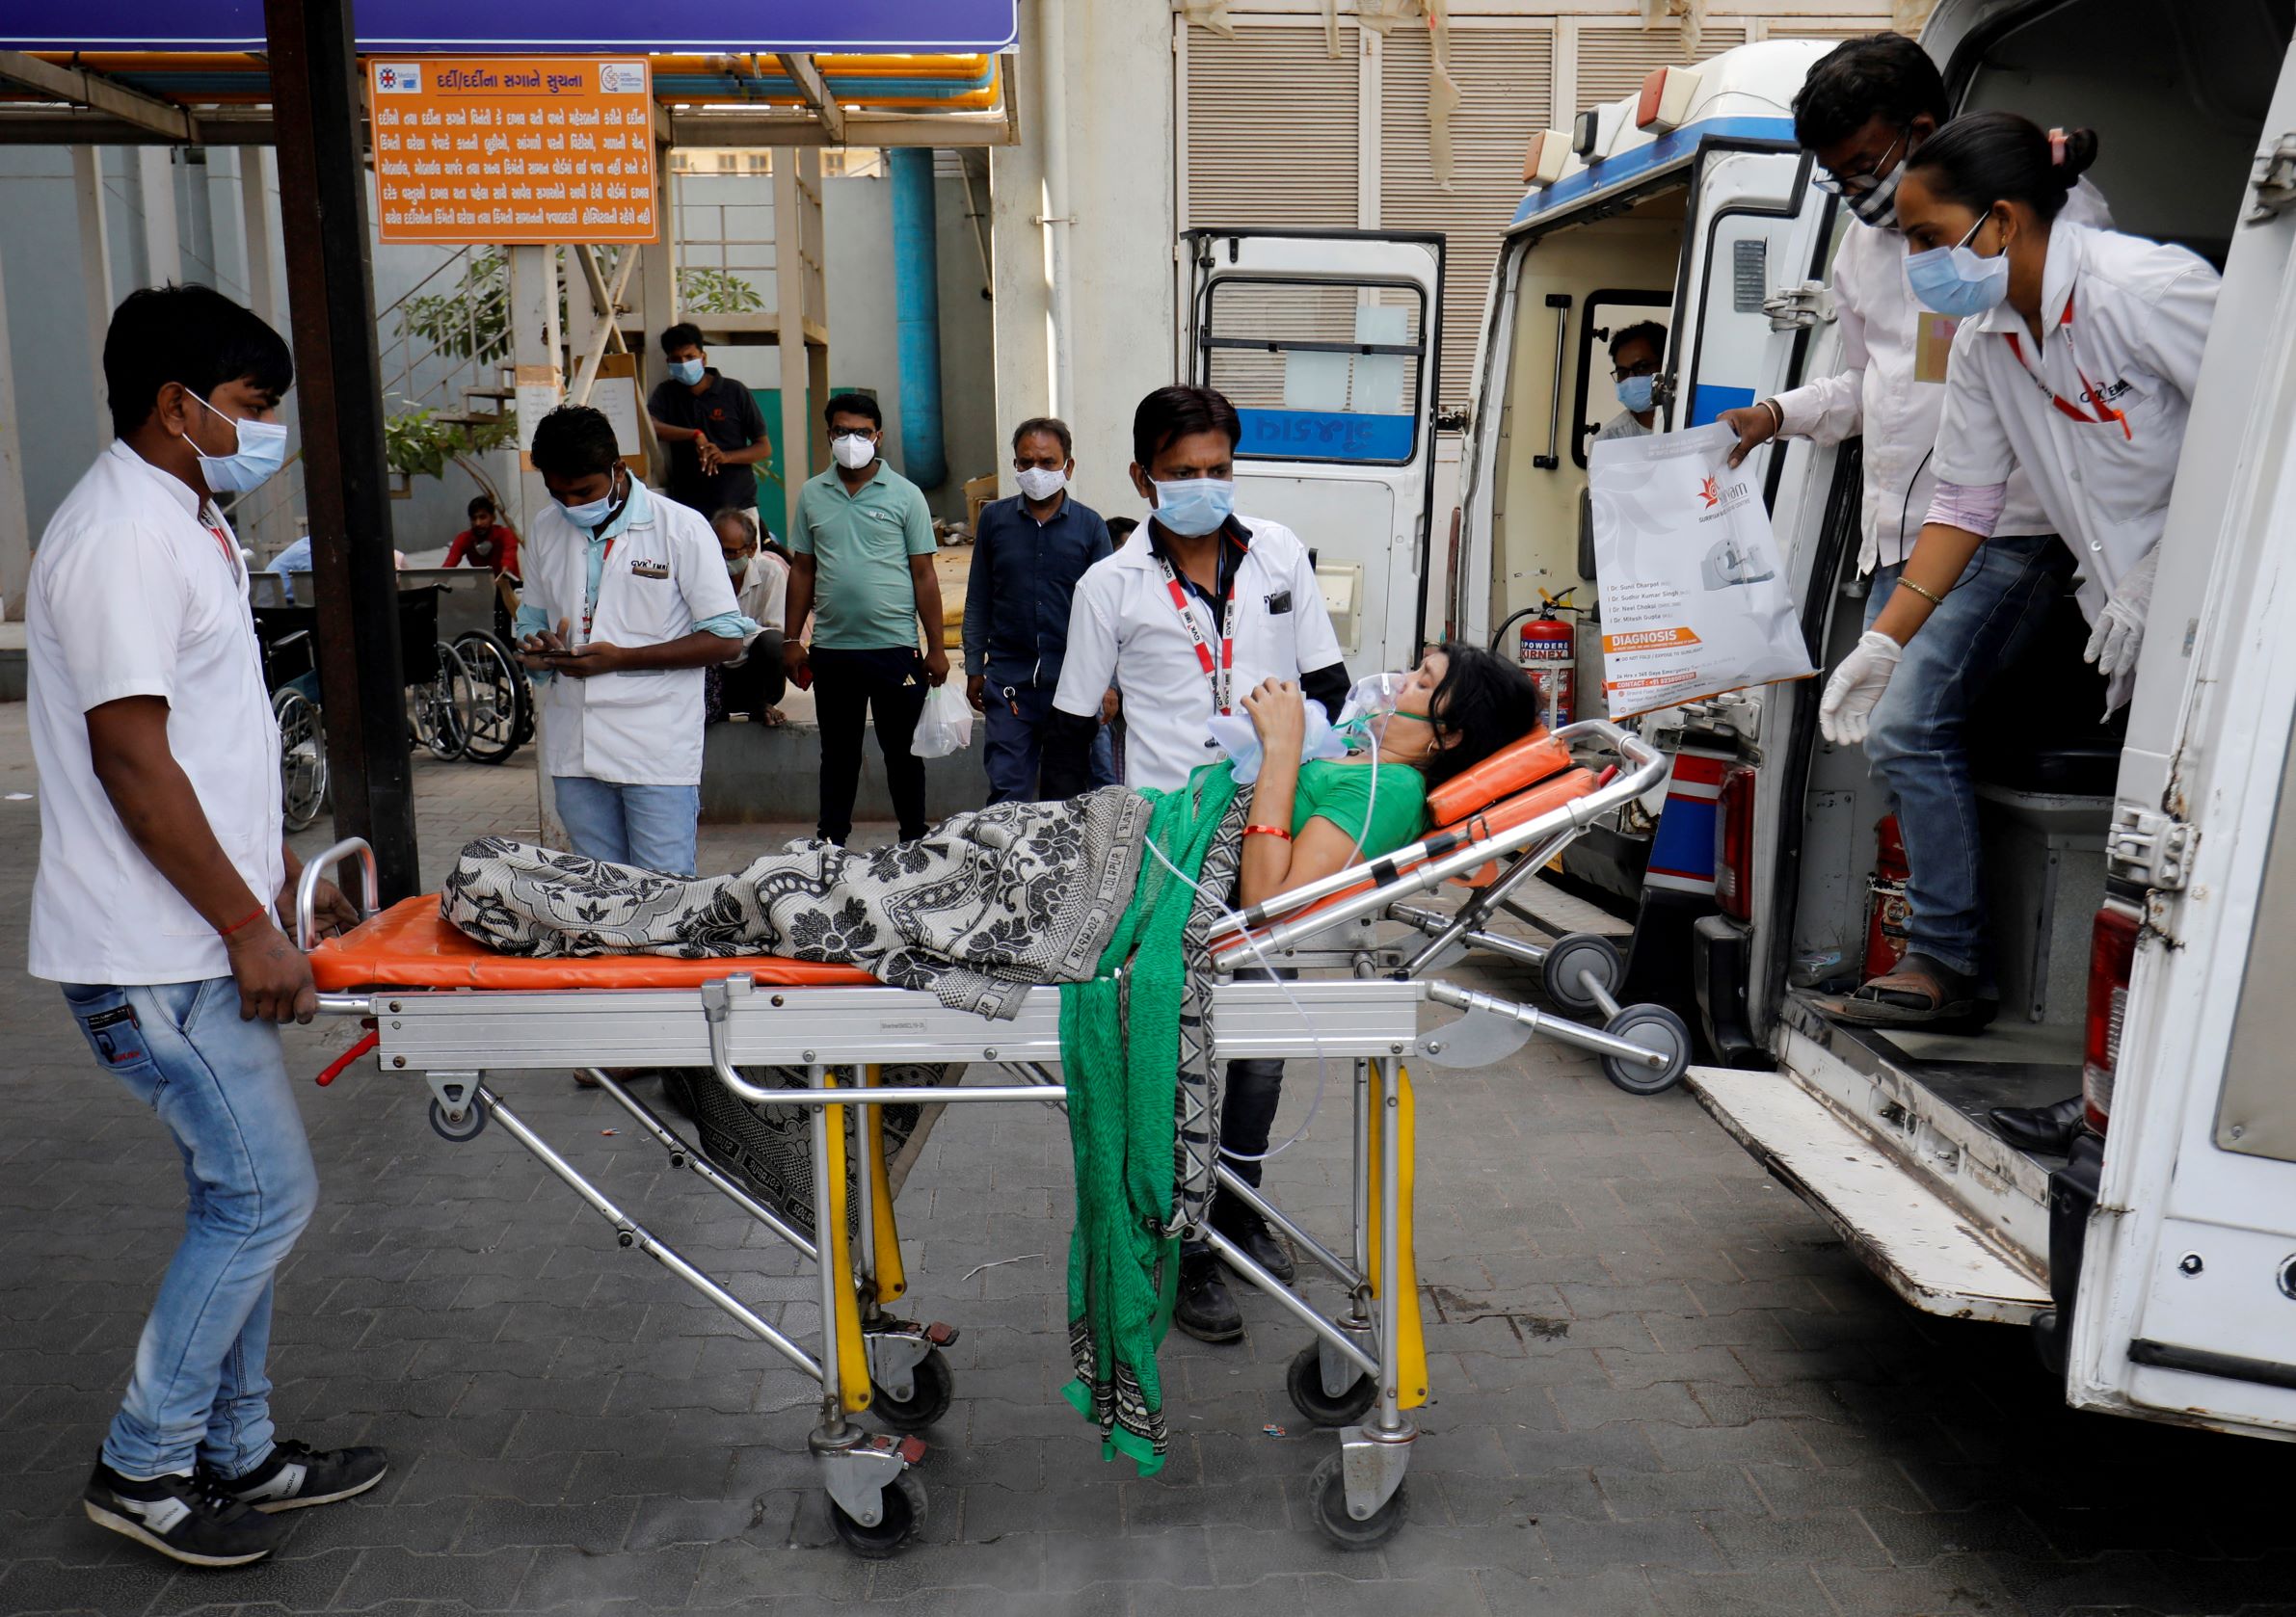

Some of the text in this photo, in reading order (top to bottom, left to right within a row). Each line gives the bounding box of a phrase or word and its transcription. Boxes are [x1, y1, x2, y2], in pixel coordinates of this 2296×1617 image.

[437, 69, 498, 91] દર્દી/દર્દીના
[547, 74, 582, 93] સુચના
[404, 114, 417, 124] તથા
[422, 109, 441, 125] દર્દીના
[446, 109, 466, 124] સગાને
[496, 109, 501, 124] કે
[627, 108, 646, 124] દર્દીના
[467, 163, 480, 174] તથા
[625, 158, 638, 173] અને
[642, 158, 648, 173] તે
[384, 184, 397, 199] દરેક
[478, 213, 491, 224] તથા
[1612, 629, 1678, 647] DIAGNOSIS
[1102, 852, 1122, 891] SOLAPUR
